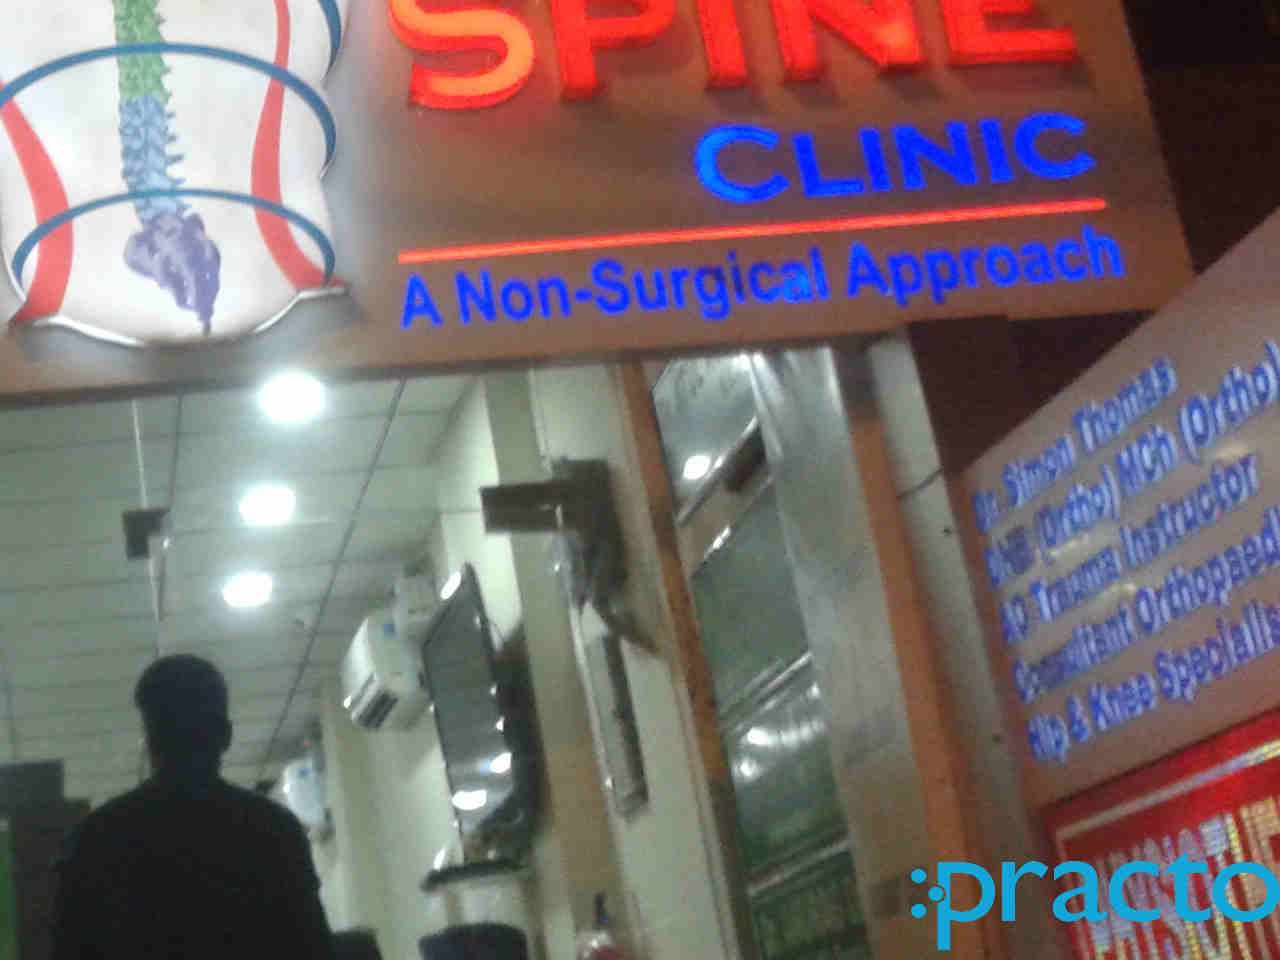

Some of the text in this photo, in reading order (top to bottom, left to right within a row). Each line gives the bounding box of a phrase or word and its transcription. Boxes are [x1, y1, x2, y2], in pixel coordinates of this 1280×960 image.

[695, 112, 1097, 203] CLINIC
[399, 224, 1126, 327] A Non-Surgical Approach
[1073, 356, 1178, 455] Thomas
[1014, 602, 1138, 704] Coultant
